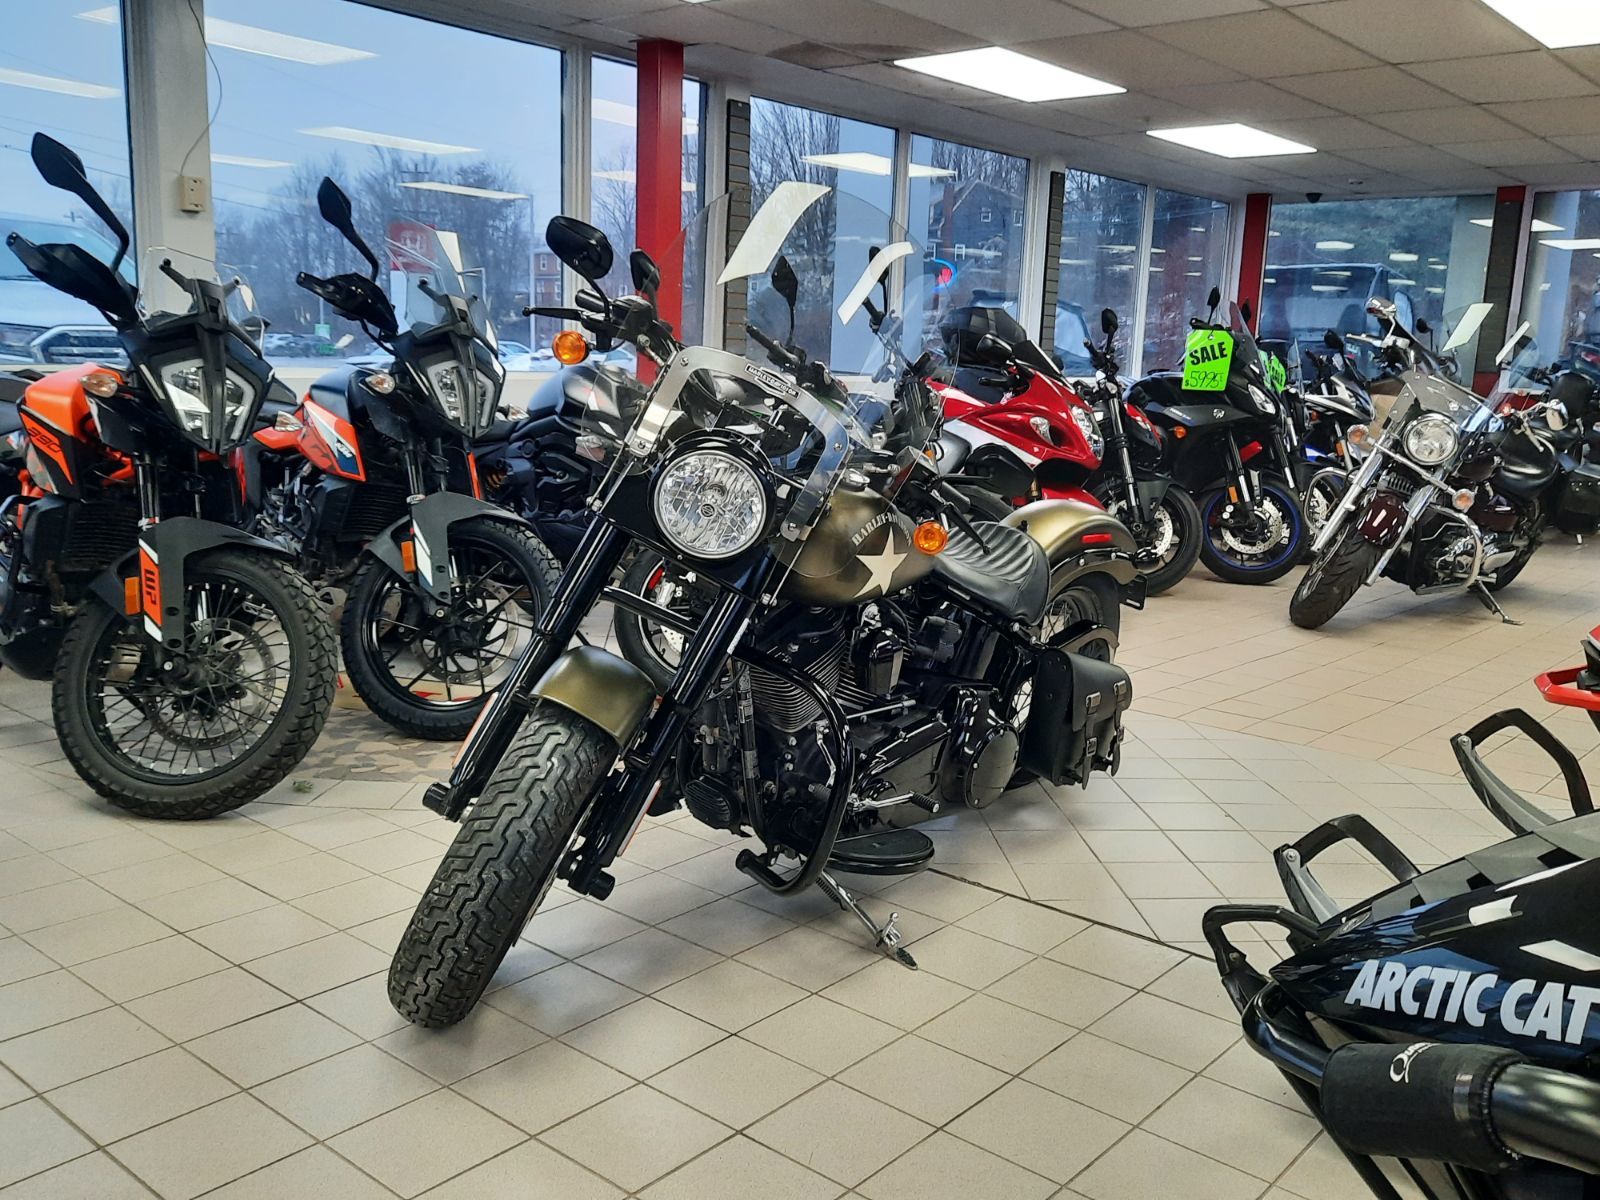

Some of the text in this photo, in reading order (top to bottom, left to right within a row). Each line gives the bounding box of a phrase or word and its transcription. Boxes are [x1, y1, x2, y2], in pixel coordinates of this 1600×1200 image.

[1189, 341, 1227, 366] SALE
[1344, 959, 1600, 1045] ARCTIC CAT
